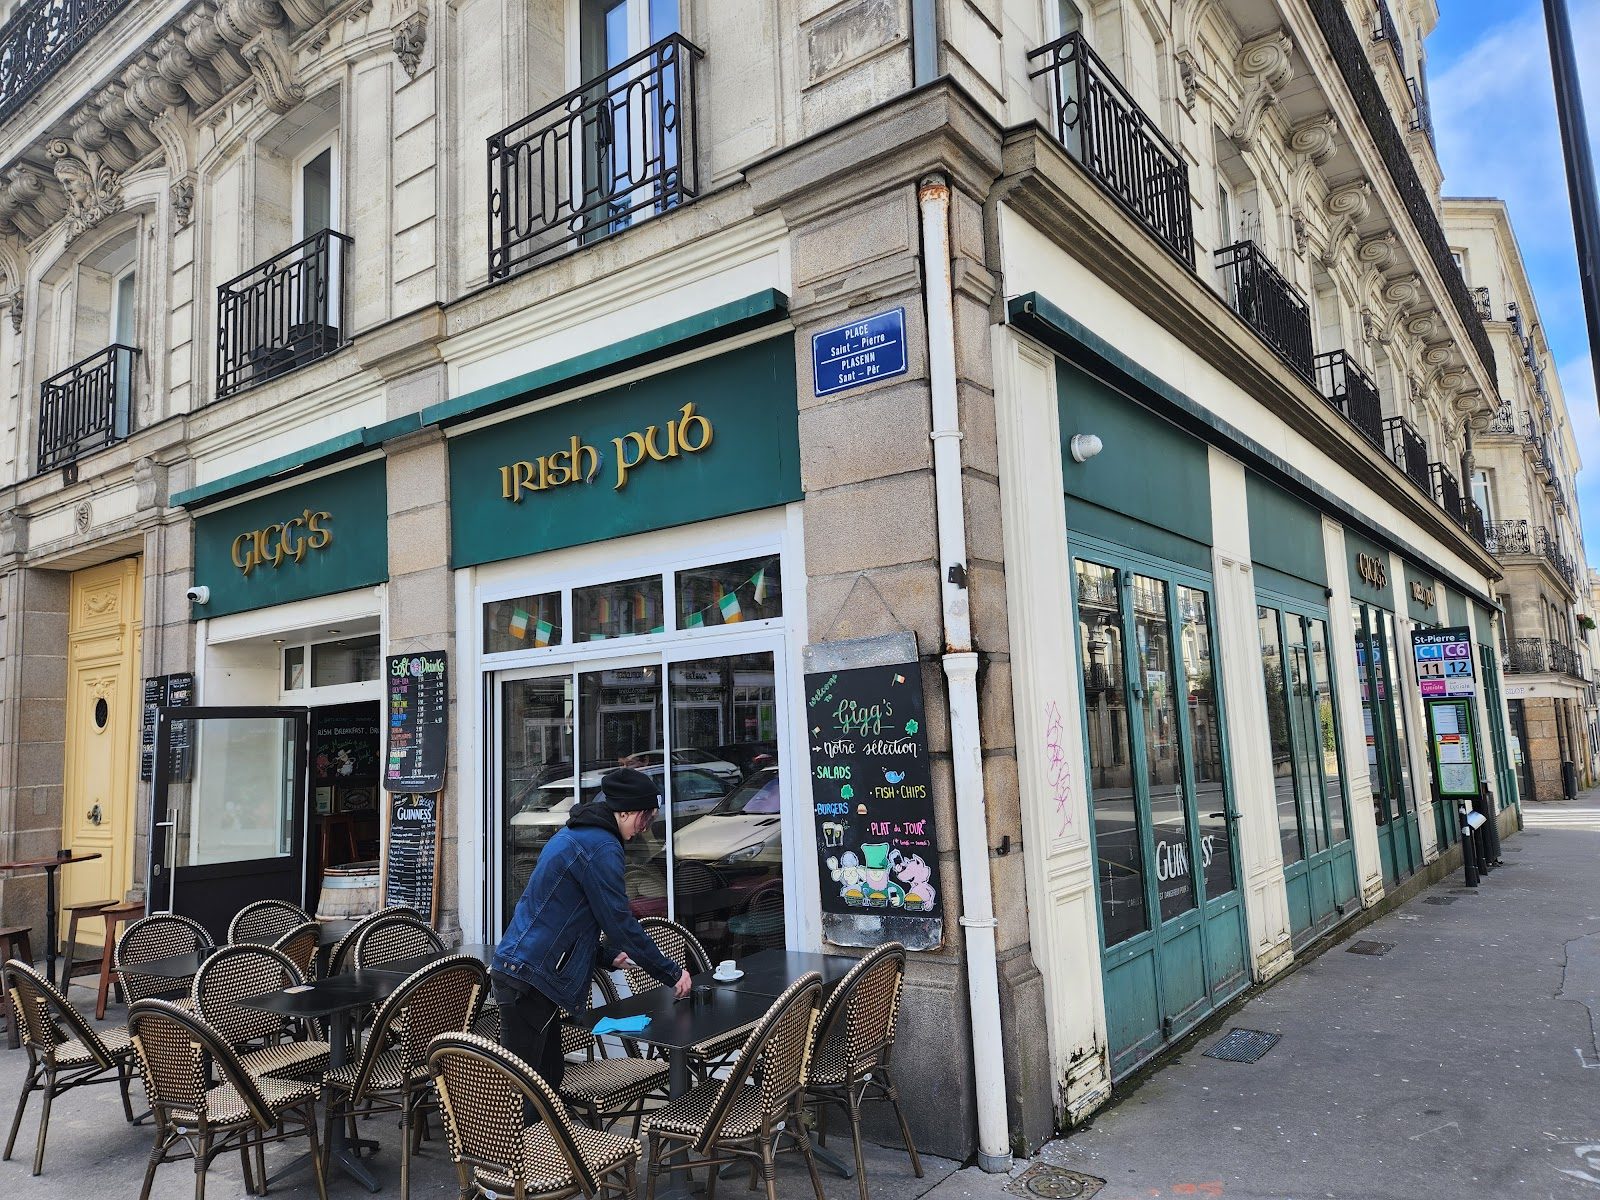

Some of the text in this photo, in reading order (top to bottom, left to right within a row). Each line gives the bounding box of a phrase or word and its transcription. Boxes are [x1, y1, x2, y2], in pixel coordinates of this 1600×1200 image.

[845, 324, 868, 340] PLACE
[831, 343, 850, 357] Saint
[862, 334, 885, 347] Pierre
[841, 352, 875, 370] PLASENN
[838, 371, 855, 383] Sant
[230, 509, 334, 577] GIGG'S
[1414, 635, 1456, 644] St-Pierre
[1421, 644, 1467, 658] C1 C6
[391, 656, 445, 678] Soft Drinks
[1422, 661, 1468, 675] 11 12
[832, 698, 893, 737] Gigg's
[817, 766, 852, 780] SALADS
[875, 786, 895, 799] FISH
[900, 785, 927, 799] CHIPS
[396, 806, 432, 820] GUINNESS
[817, 802, 849, 817] BURGERS
[870, 822, 891, 836] PLAT
[1156, 835, 1215, 881] GUINSS
